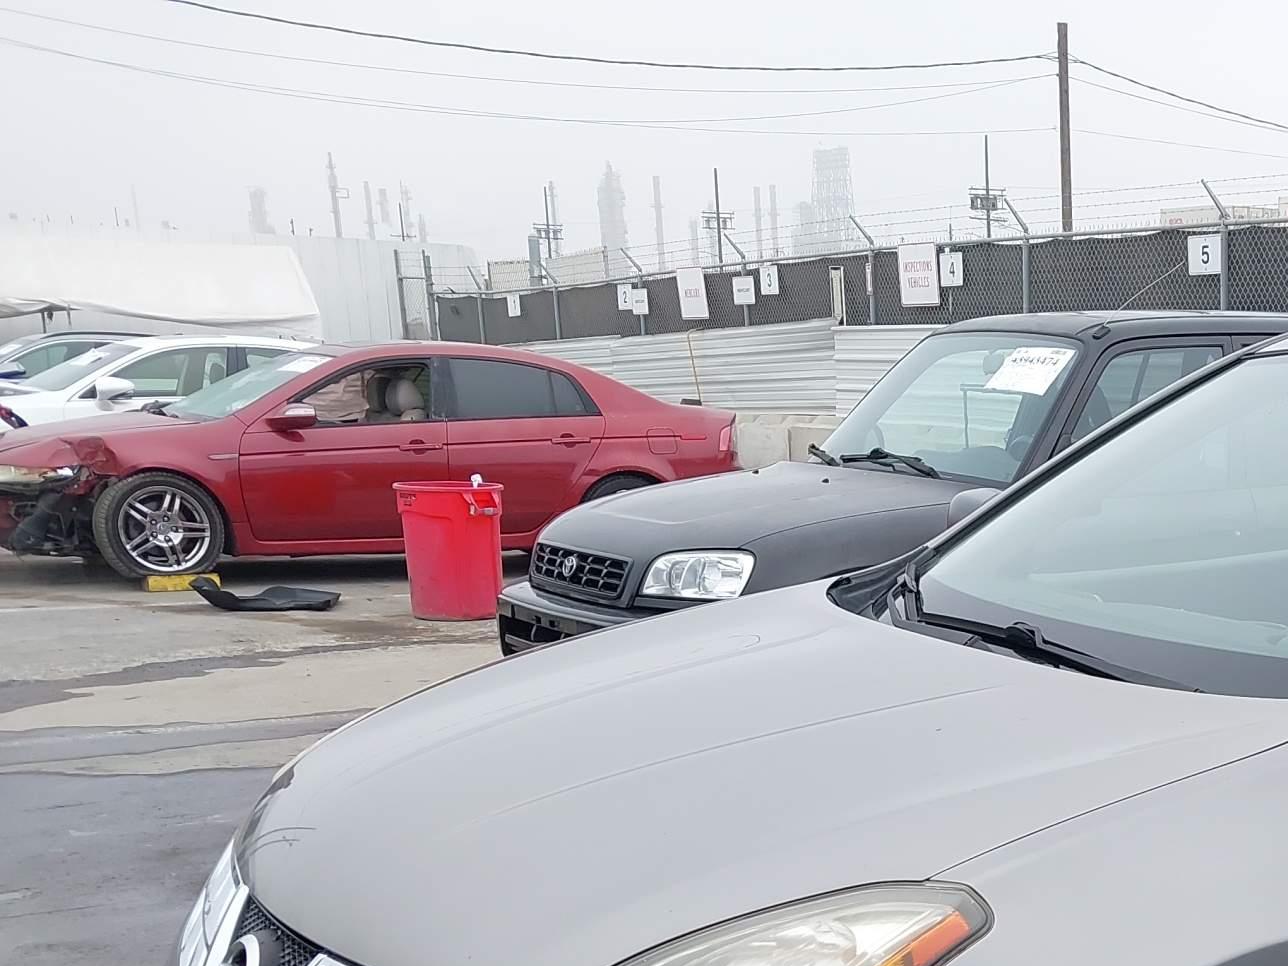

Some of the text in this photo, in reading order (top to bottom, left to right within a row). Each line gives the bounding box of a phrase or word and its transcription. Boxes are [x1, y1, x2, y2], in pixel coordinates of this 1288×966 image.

[1201, 245, 1210, 265] 5
[903, 260, 932, 273] INSPECTIONS
[949, 261, 956, 277] 4
[766, 272, 773, 288] 3
[908, 276, 930, 288] VEHICLES
[622, 290, 628, 304] 2
